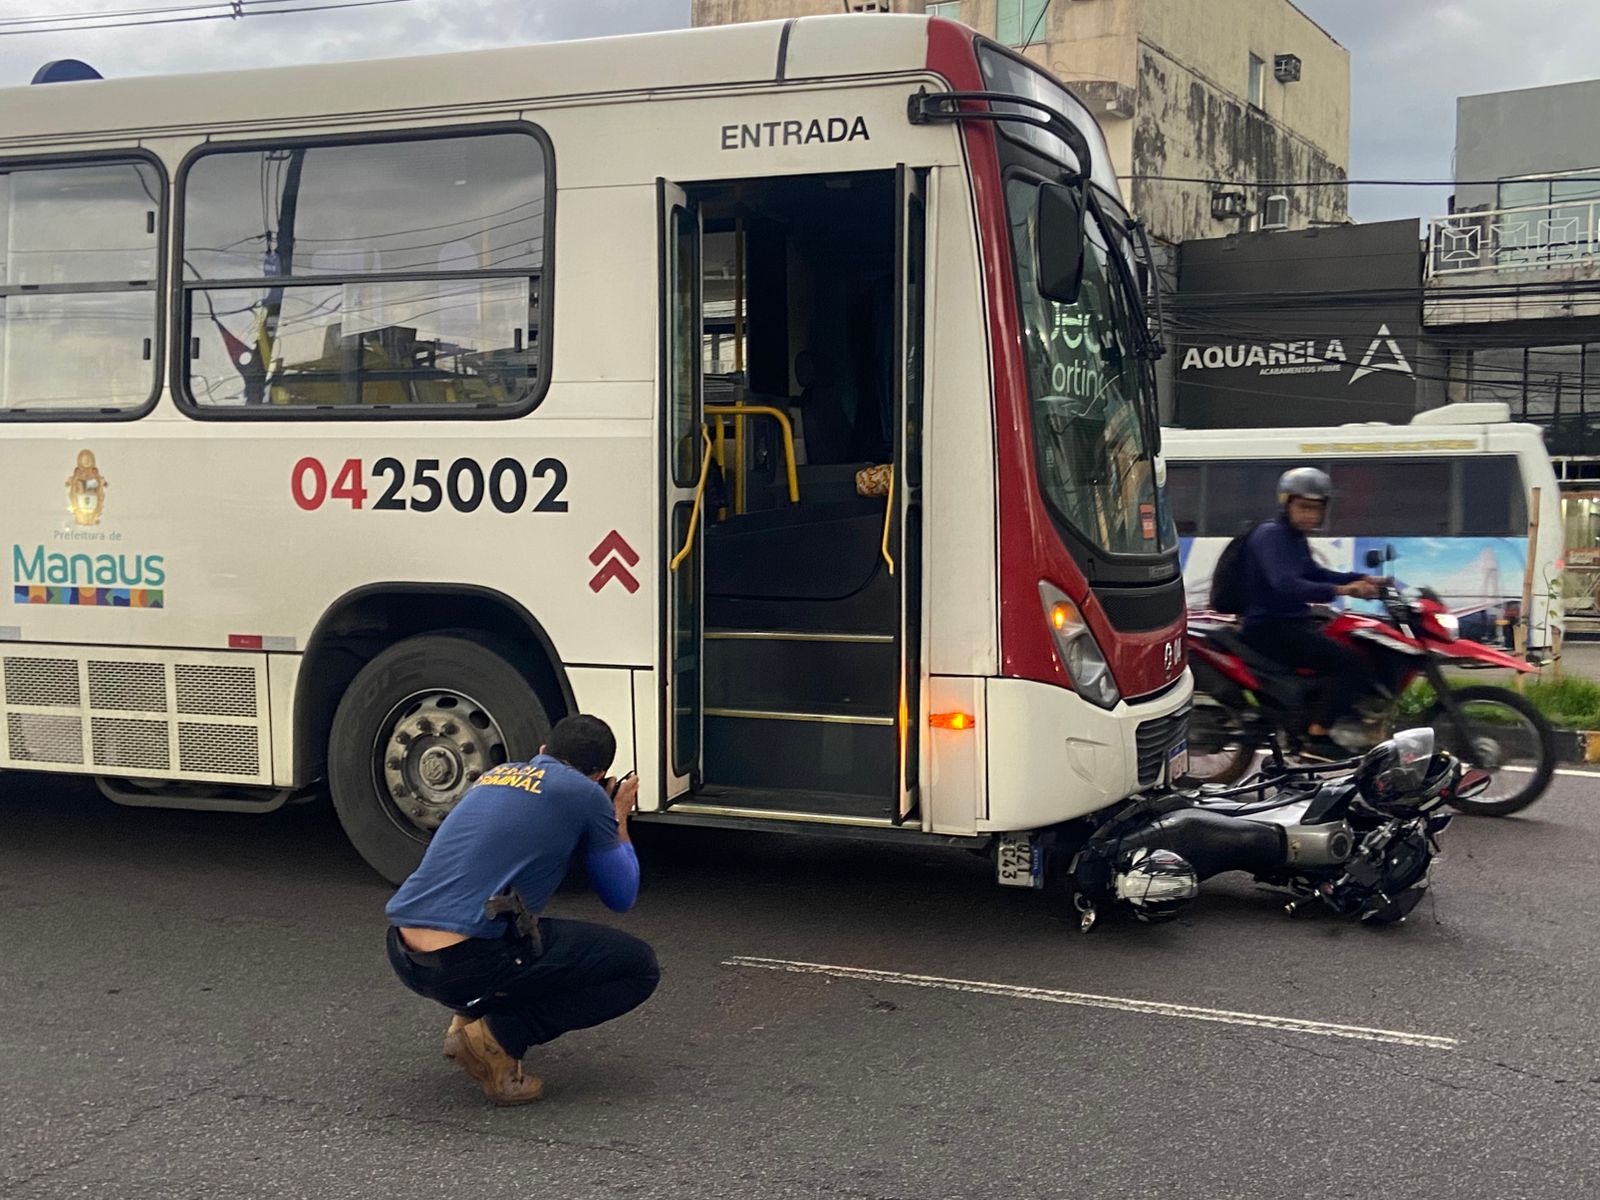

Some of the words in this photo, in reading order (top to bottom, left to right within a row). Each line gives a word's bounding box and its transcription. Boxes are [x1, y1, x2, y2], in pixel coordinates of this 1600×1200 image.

[721, 116, 870, 150] ENTRADA
[1181, 339, 1347, 370] AQUARELA
[291, 457, 569, 513] 0425002
[54, 530, 106, 541] Prefeitura
[109, 531, 122, 541] de
[13, 544, 165, 586] Manaus
